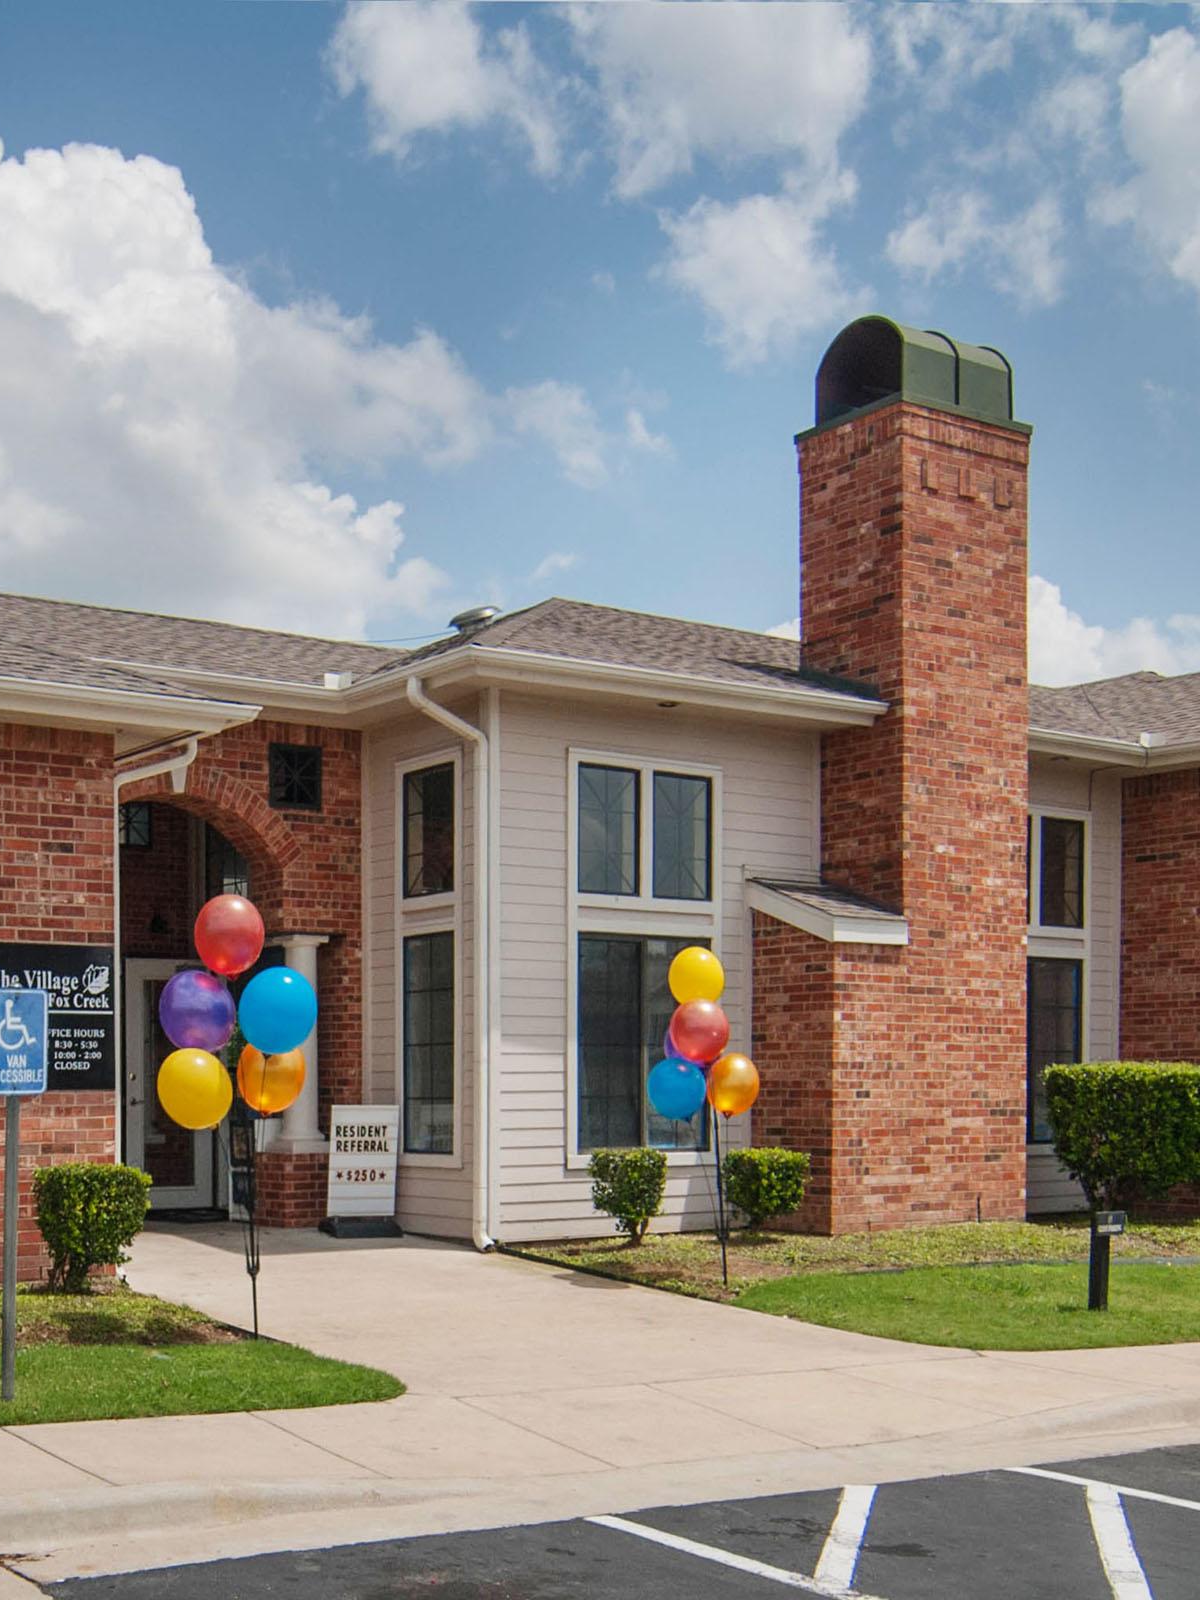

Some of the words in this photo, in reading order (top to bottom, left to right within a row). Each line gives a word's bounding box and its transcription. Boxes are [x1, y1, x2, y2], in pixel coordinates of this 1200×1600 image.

[23, 970, 79, 994] Village
[48, 993, 71, 1008] Fox
[73, 993, 109, 1008] Creek
[48, 1029, 71, 1038] FICE
[73, 1029, 105, 1038] HOURS
[54, 1040, 73, 1049] 8:30
[80, 1041, 98, 1049] 5:30
[6, 1054, 27, 1068] VAN
[54, 1051, 77, 1059] 10:00
[84, 1051, 102, 1059] 2:00
[54, 1061, 90, 1070] CLOSED
[335, 1125, 388, 1138] RESIDENT
[336, 1140, 389, 1152] REFERRAL
[346, 1169, 376, 1181] $250
